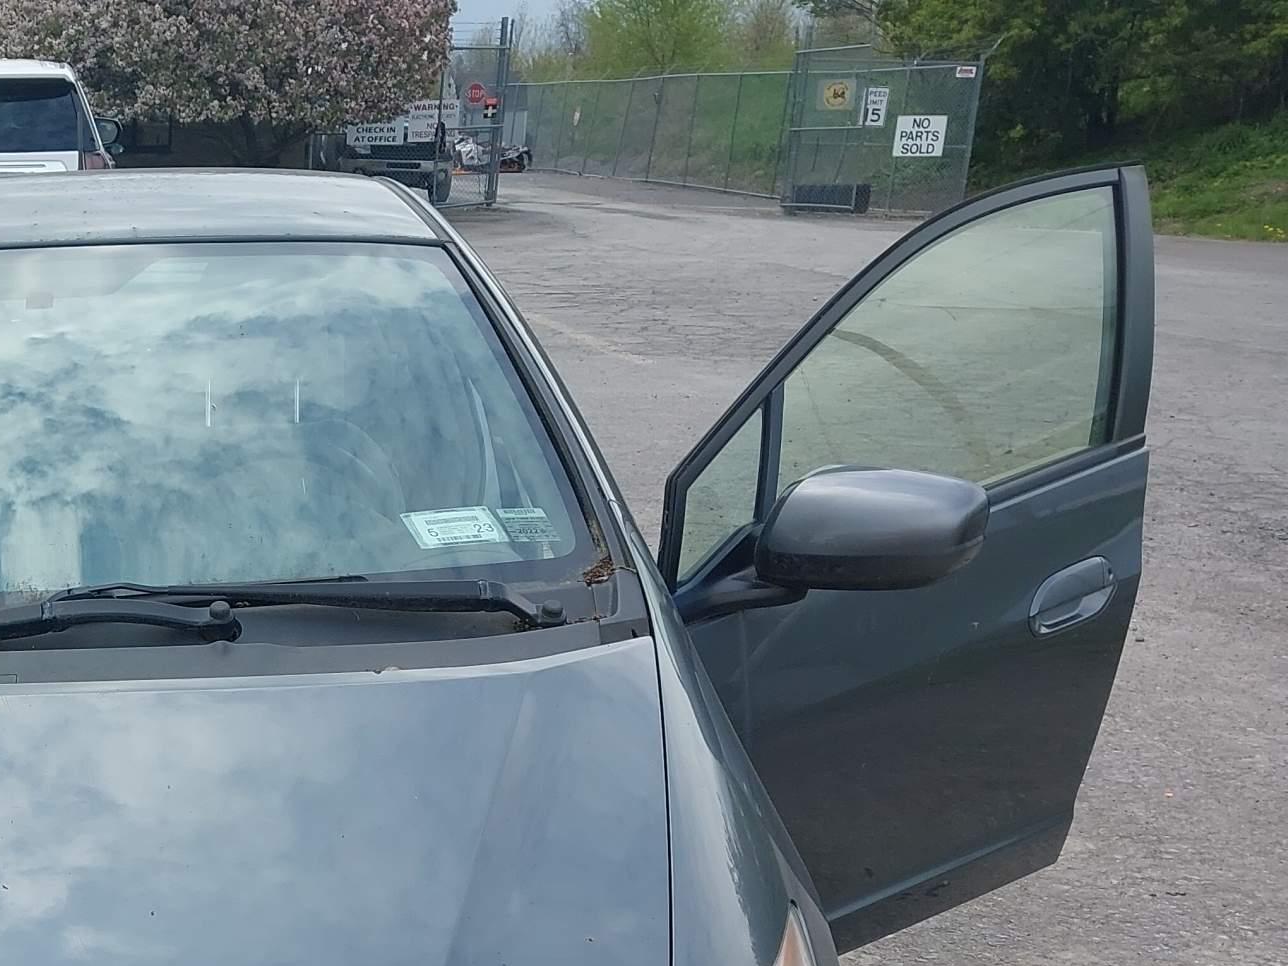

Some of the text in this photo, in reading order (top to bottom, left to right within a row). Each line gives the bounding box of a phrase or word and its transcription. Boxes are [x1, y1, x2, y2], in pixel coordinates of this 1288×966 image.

[465, 89, 485, 98] STOP
[413, 103, 455, 112] WARNNG
[912, 117, 931, 130] NO
[356, 126, 396, 134] CHECK IN
[368, 135, 398, 143] OFFICE
[900, 130, 940, 142] PARTS
[900, 143, 935, 155] SOLD
[427, 522, 495, 538] 5 23
